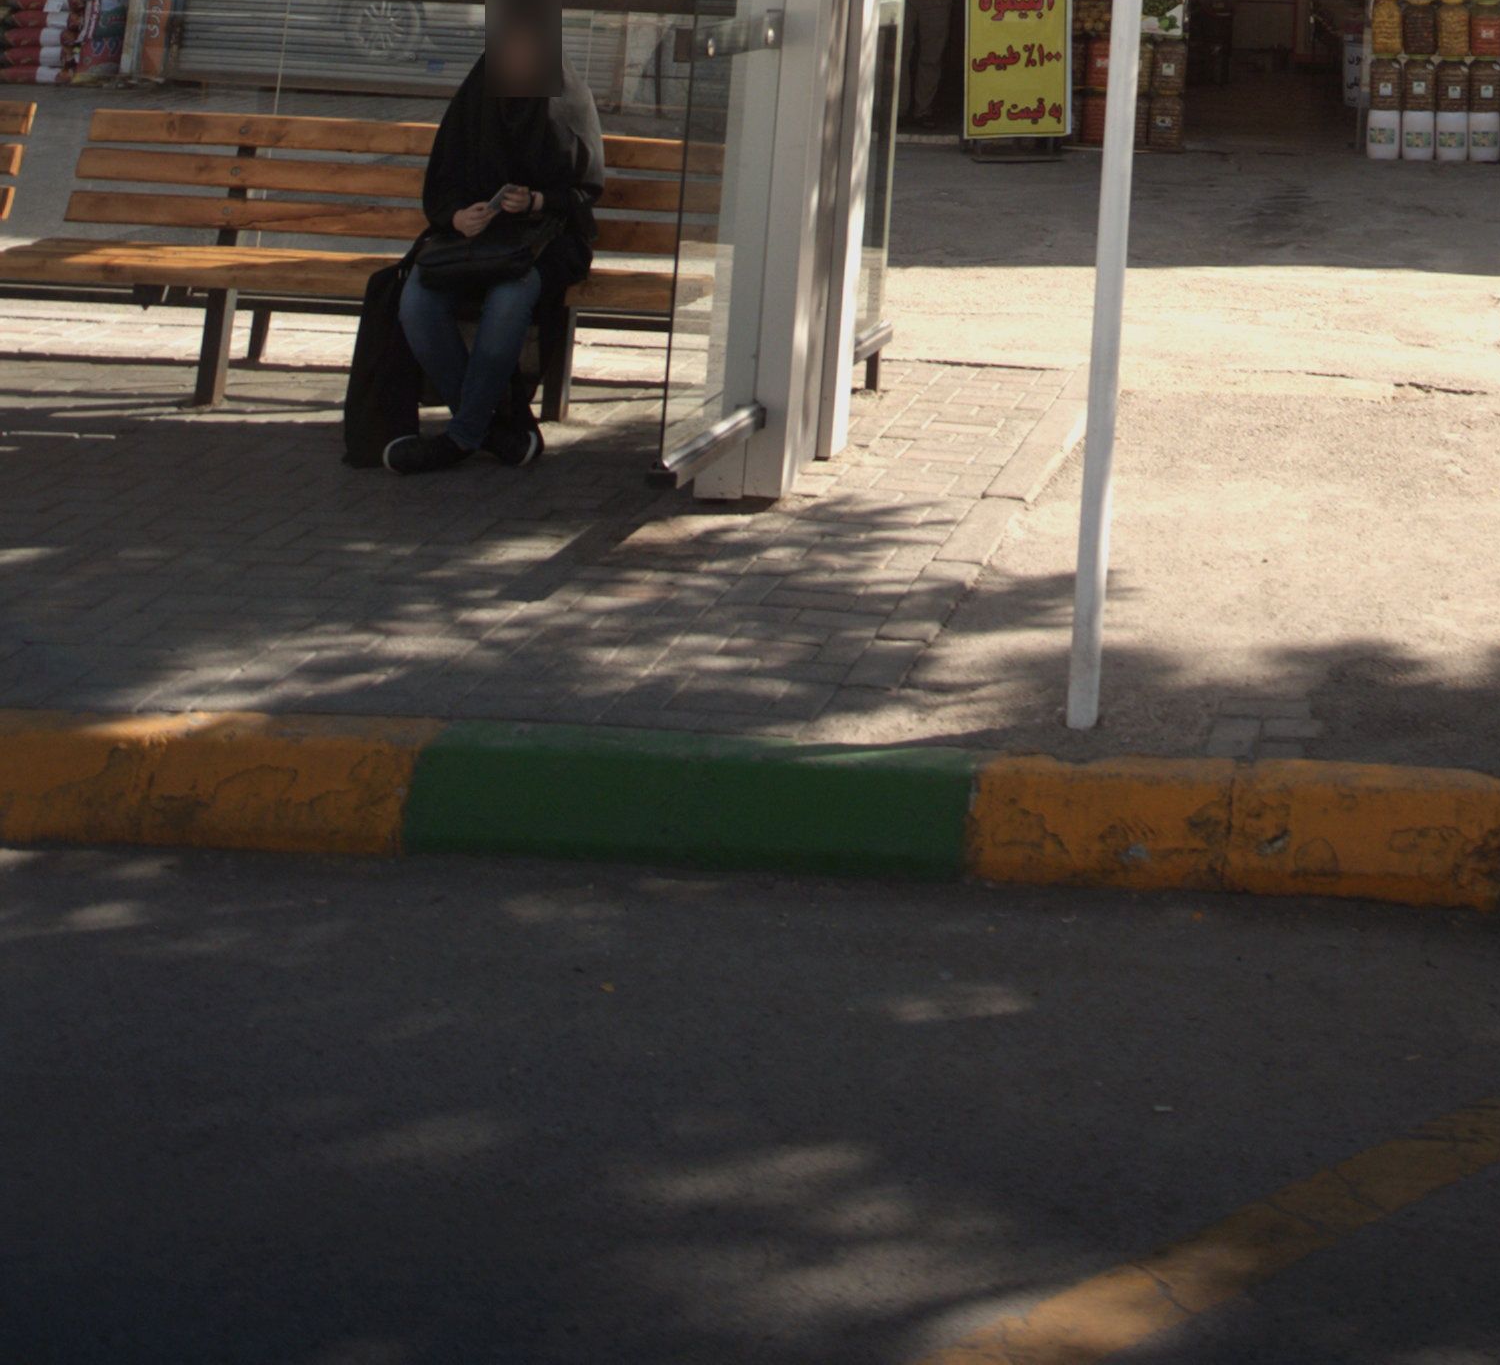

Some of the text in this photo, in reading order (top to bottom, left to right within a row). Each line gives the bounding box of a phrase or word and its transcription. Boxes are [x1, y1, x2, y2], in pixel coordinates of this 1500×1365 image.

[971, 45, 1021, 73] طبیعی
[1006, 98, 1046, 125] قیمت
[1049, 101, 1063, 124] به
